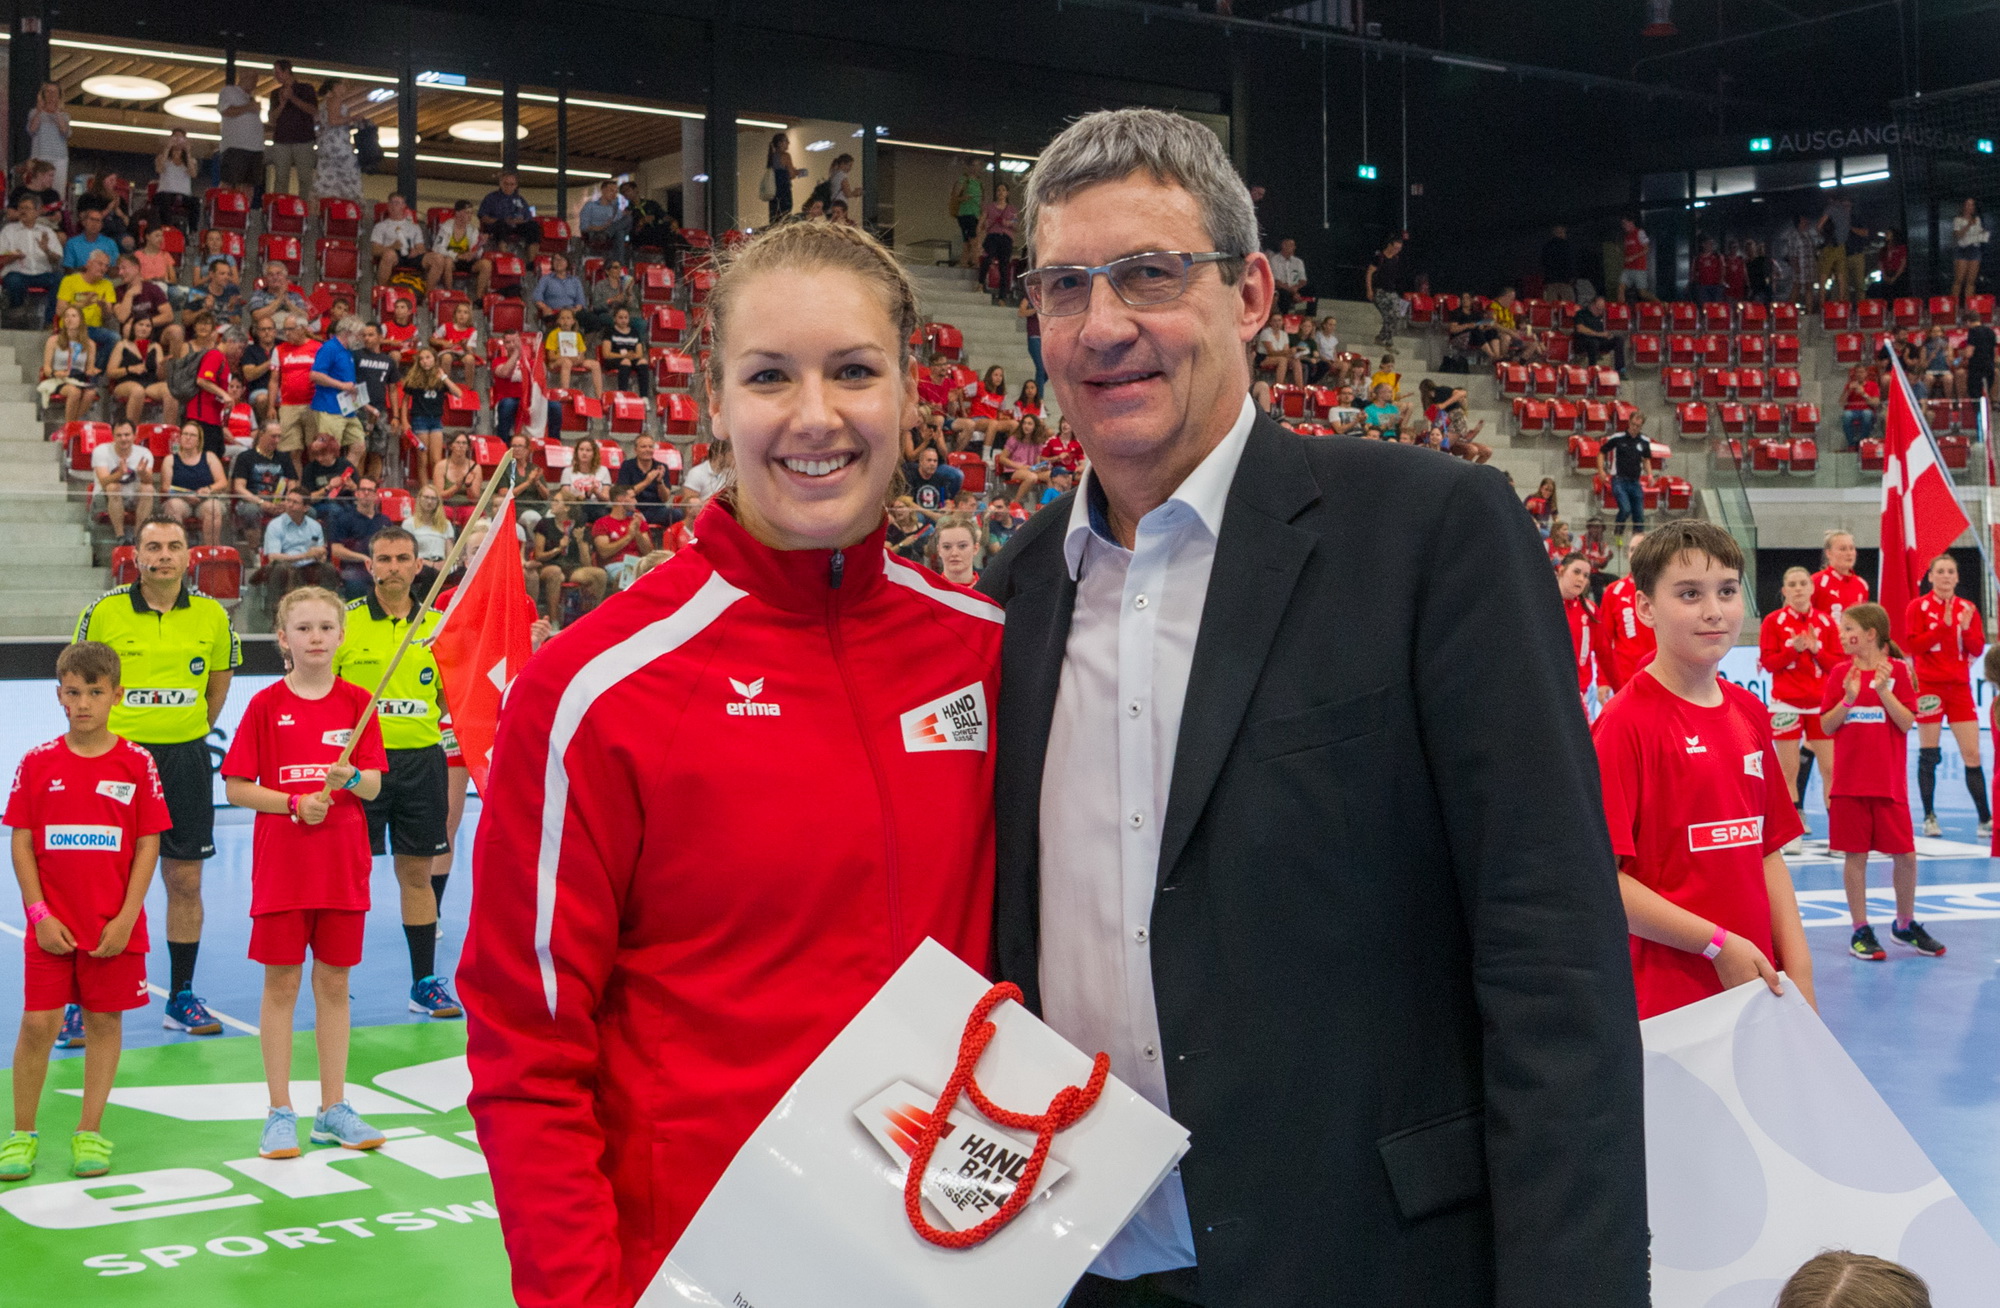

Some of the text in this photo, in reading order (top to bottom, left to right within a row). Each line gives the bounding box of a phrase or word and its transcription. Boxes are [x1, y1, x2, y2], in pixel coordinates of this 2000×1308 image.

[1778, 124, 1900, 153] AUSGANG
[359, 358, 390, 370] MIAMI
[726, 698, 781, 717] erima
[942, 693, 976, 720] HAND
[1845, 709, 1884, 721] ONCORDIA
[952, 710, 983, 730] BALL
[289, 768, 328, 780] SPA
[49, 831, 118, 848] CONCORDIA
[1711, 823, 1760, 843] SPAR
[0, 1126, 490, 1229] eri
[83, 1200, 500, 1277] SPORTSW
